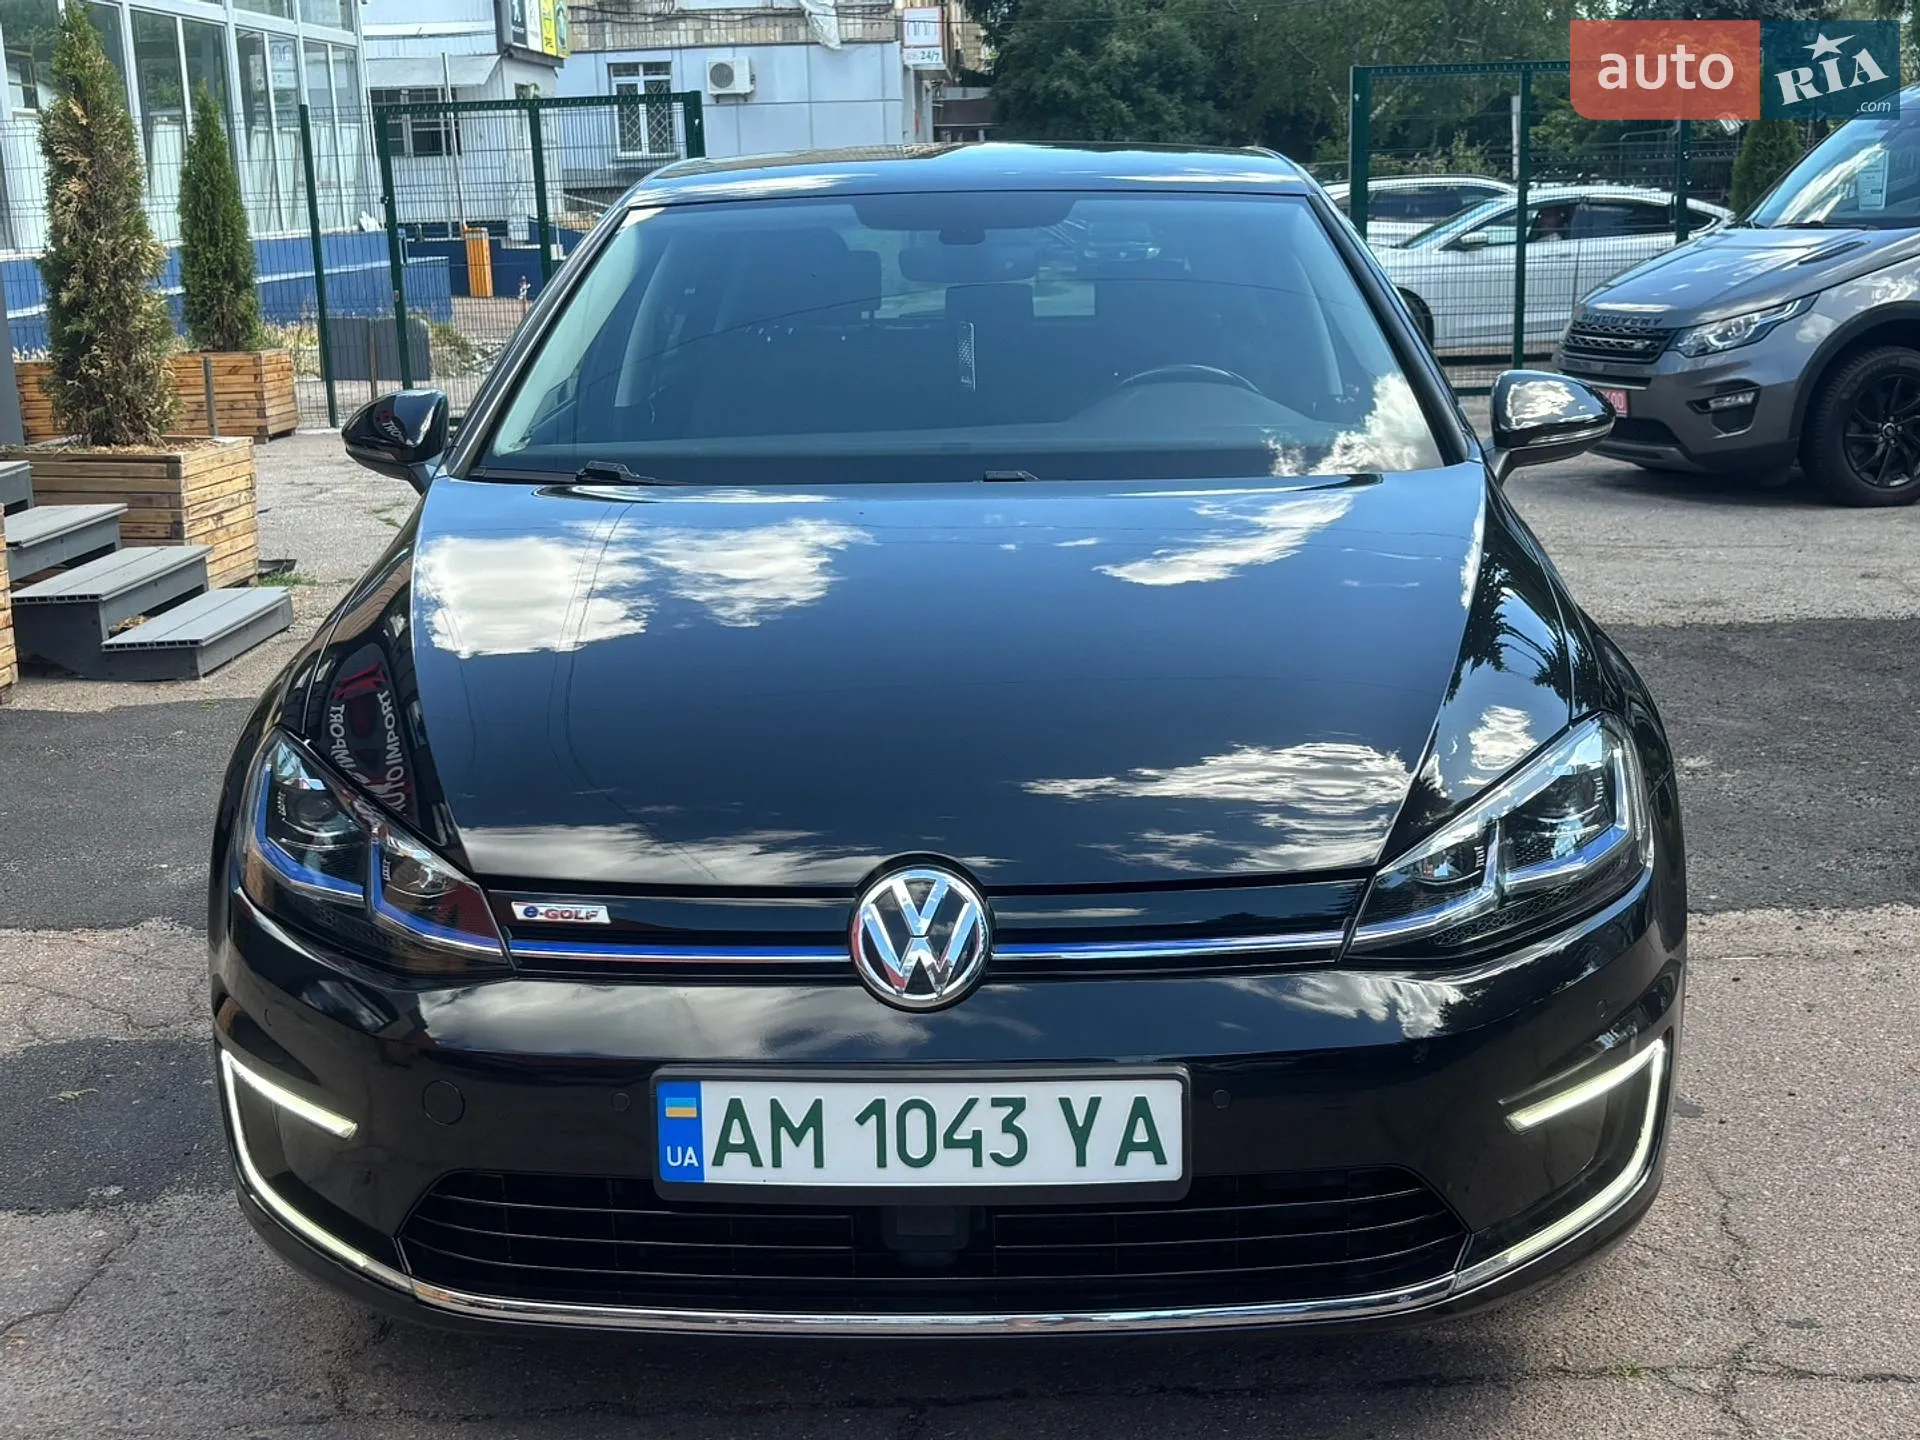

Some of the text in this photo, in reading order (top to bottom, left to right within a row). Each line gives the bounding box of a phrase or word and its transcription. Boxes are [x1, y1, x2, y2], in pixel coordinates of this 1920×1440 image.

[666, 1145, 699, 1167] UA
[711, 1095, 1168, 1169] AM 1043 YA
